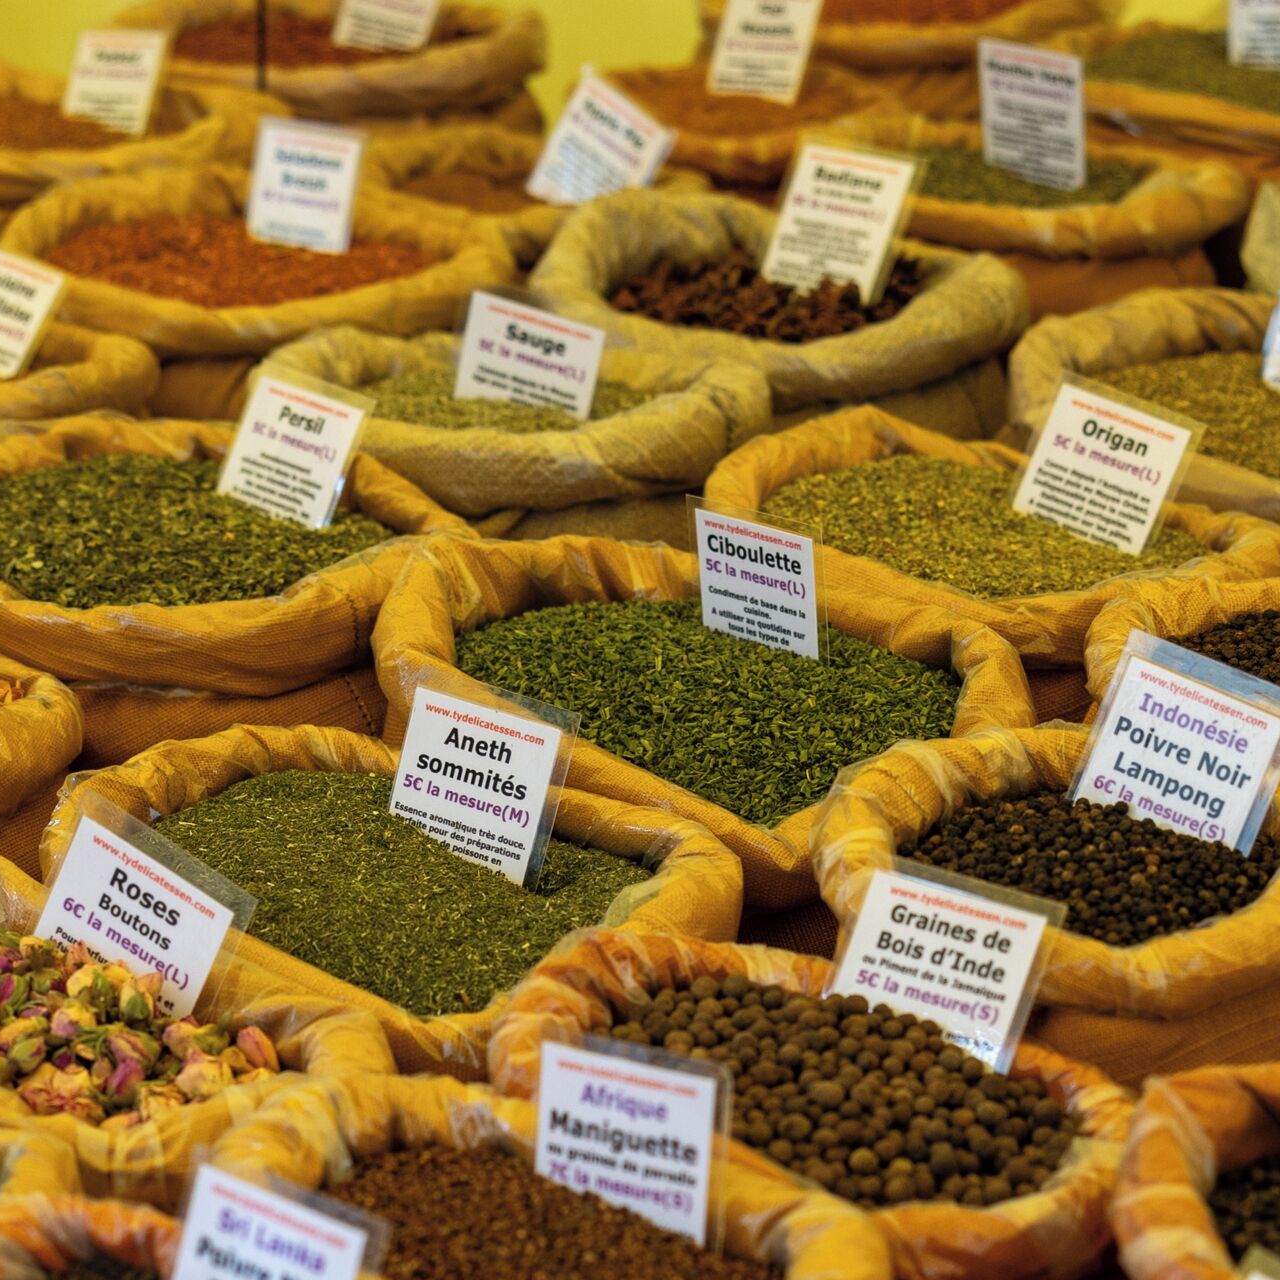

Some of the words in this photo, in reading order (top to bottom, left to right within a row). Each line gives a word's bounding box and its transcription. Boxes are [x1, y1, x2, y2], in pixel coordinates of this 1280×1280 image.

[505, 322, 566, 357] Sauge
[277, 404, 326, 435] Persil
[1081, 418, 1148, 457] Origan
[703, 518, 802, 551] www.tydelicatessen.com
[706, 533, 802, 576] Ciboulette
[704, 556, 722, 574] 5€
[723, 561, 737, 578] la
[739, 568, 806, 600] mesure(L)
[707, 584, 748, 603] Condiment
[748, 595, 759, 606] de
[758, 598, 778, 612] base
[778, 603, 798, 617] dans
[797, 608, 806, 620] la
[742, 605, 772, 620] cuisine.
[424, 702, 545, 747] www.tydelicatessen.com
[1137, 691, 1249, 754] Indonésie
[1139, 669, 1268, 731] www.tydelicatessen.com
[442, 726, 512, 765] Aneth
[1112, 714, 1192, 765] Poivre
[1195, 750, 1252, 789] Noir
[401, 772, 424, 792] 5€
[425, 779, 441, 797] la
[443, 788, 530, 829] mesure(M)
[415, 752, 528, 801] sommités
[1112, 750, 1226, 820] Lampong
[393, 799, 428, 819] Essence
[427, 812, 478, 835] aromatique
[477, 827, 496, 841] très
[496, 833, 526, 851] douce.
[92, 834, 216, 920] www.tydelicatessen.com
[108, 866, 181, 927] Roses
[62, 896, 86, 919] 6€
[85, 910, 103, 932] la
[104, 926, 189, 991] mesure(L)
[97, 891, 172, 951] Boutons
[889, 903, 977, 944] Graines
[981, 929, 1012, 954] de
[875, 929, 925, 960] Bois
[929, 945, 1006, 983] d'Inde
[579, 1082, 668, 1122] Afrique
[548, 1108, 698, 1165] Maniguette
